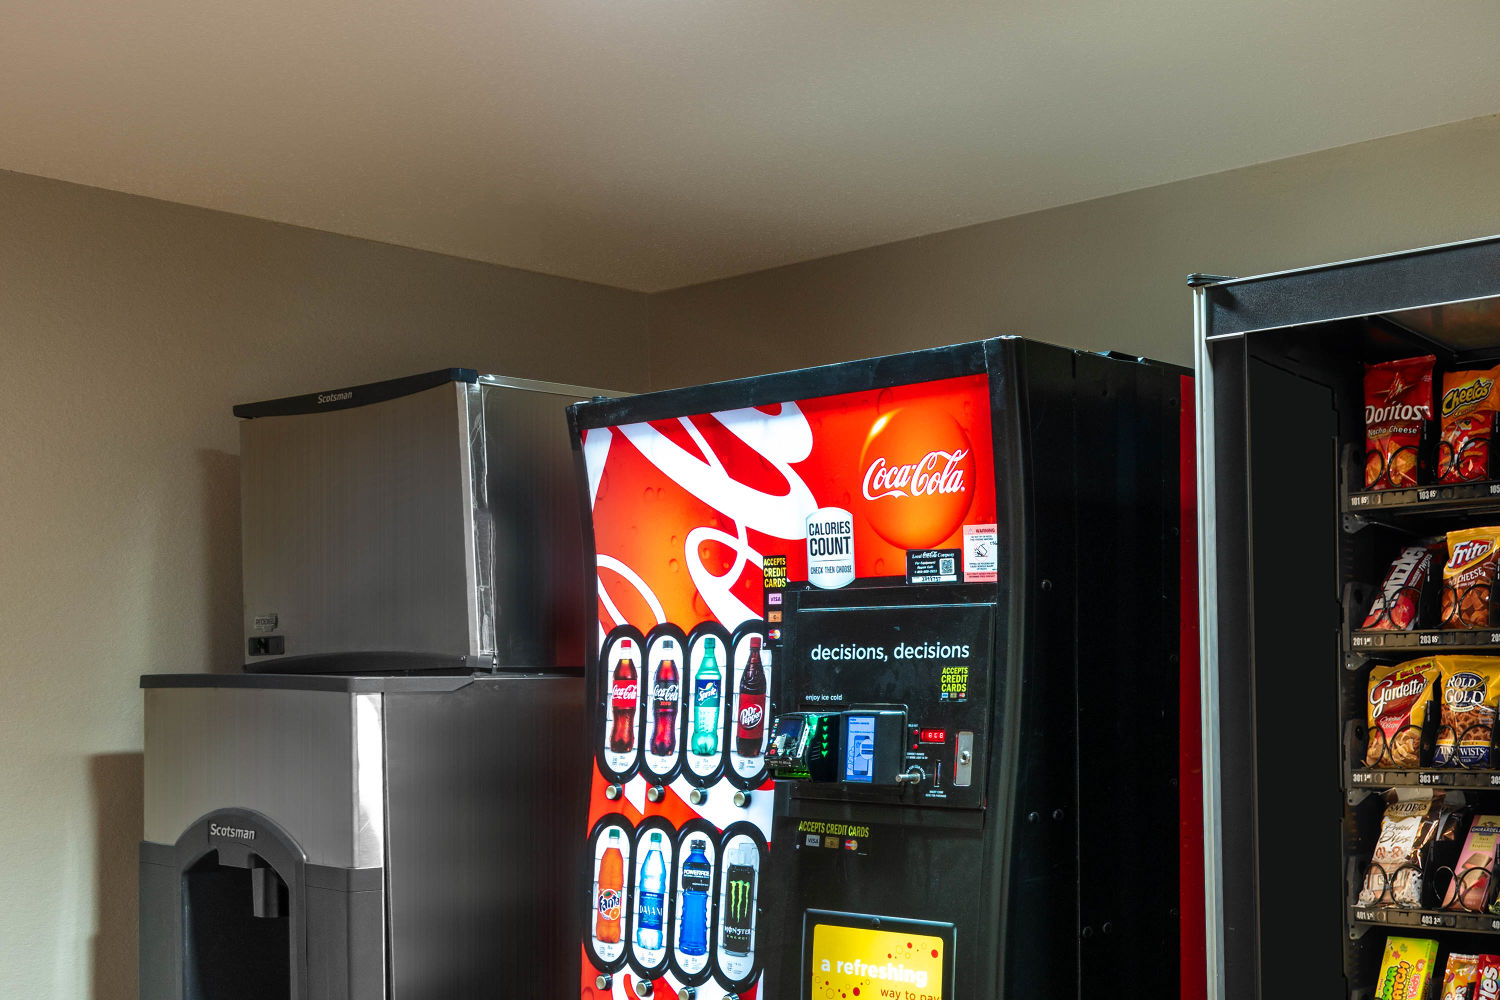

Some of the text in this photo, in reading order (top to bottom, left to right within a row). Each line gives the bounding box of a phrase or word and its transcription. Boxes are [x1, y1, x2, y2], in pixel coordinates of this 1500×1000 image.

[317, 391, 353, 404] Scotsman
[1442, 378, 1495, 418] Cheetos
[1365, 401, 1427, 424] Doritos
[1368, 425, 1418, 437] Nacho Cheese
[862, 448, 969, 501] Coca-Cola
[1419, 491, 1430, 500] 103
[1490, 484, 1500, 494] 105
[1351, 497, 1361, 506] 101
[808, 520, 851, 537] CALORIES
[809, 536, 851, 557] COUNT
[1448, 540, 1493, 569] Fritos
[763, 557, 786, 566] ACCEPTS
[763, 567, 787, 577] CREDIT
[810, 564, 852, 575] CHECK THEN CHOOSE
[1457, 567, 1486, 584] CHEESE
[764, 578, 787, 588] CARDS
[1420, 635, 1431, 644] 203
[810, 642, 970, 662] decisions, decisions
[941, 667, 969, 675] ACCEPTS
[940, 675, 969, 684] CREDIT
[1447, 675, 1477, 688] ROLD
[698, 685, 719, 701] Sprite
[941, 683, 967, 693] CARDS
[805, 694, 821, 702] enjoy
[1445, 689, 1485, 704] GOLD
[740, 710, 762, 728] Pepper
[1420, 774, 1432, 783] 303
[210, 823, 256, 840] Scotsman
[798, 820, 870, 838] ACCEPTS CREDIT CARDS
[820, 958, 928, 989] a refreshing
[880, 987, 902, 1000] way
[905, 990, 917, 1000] to
